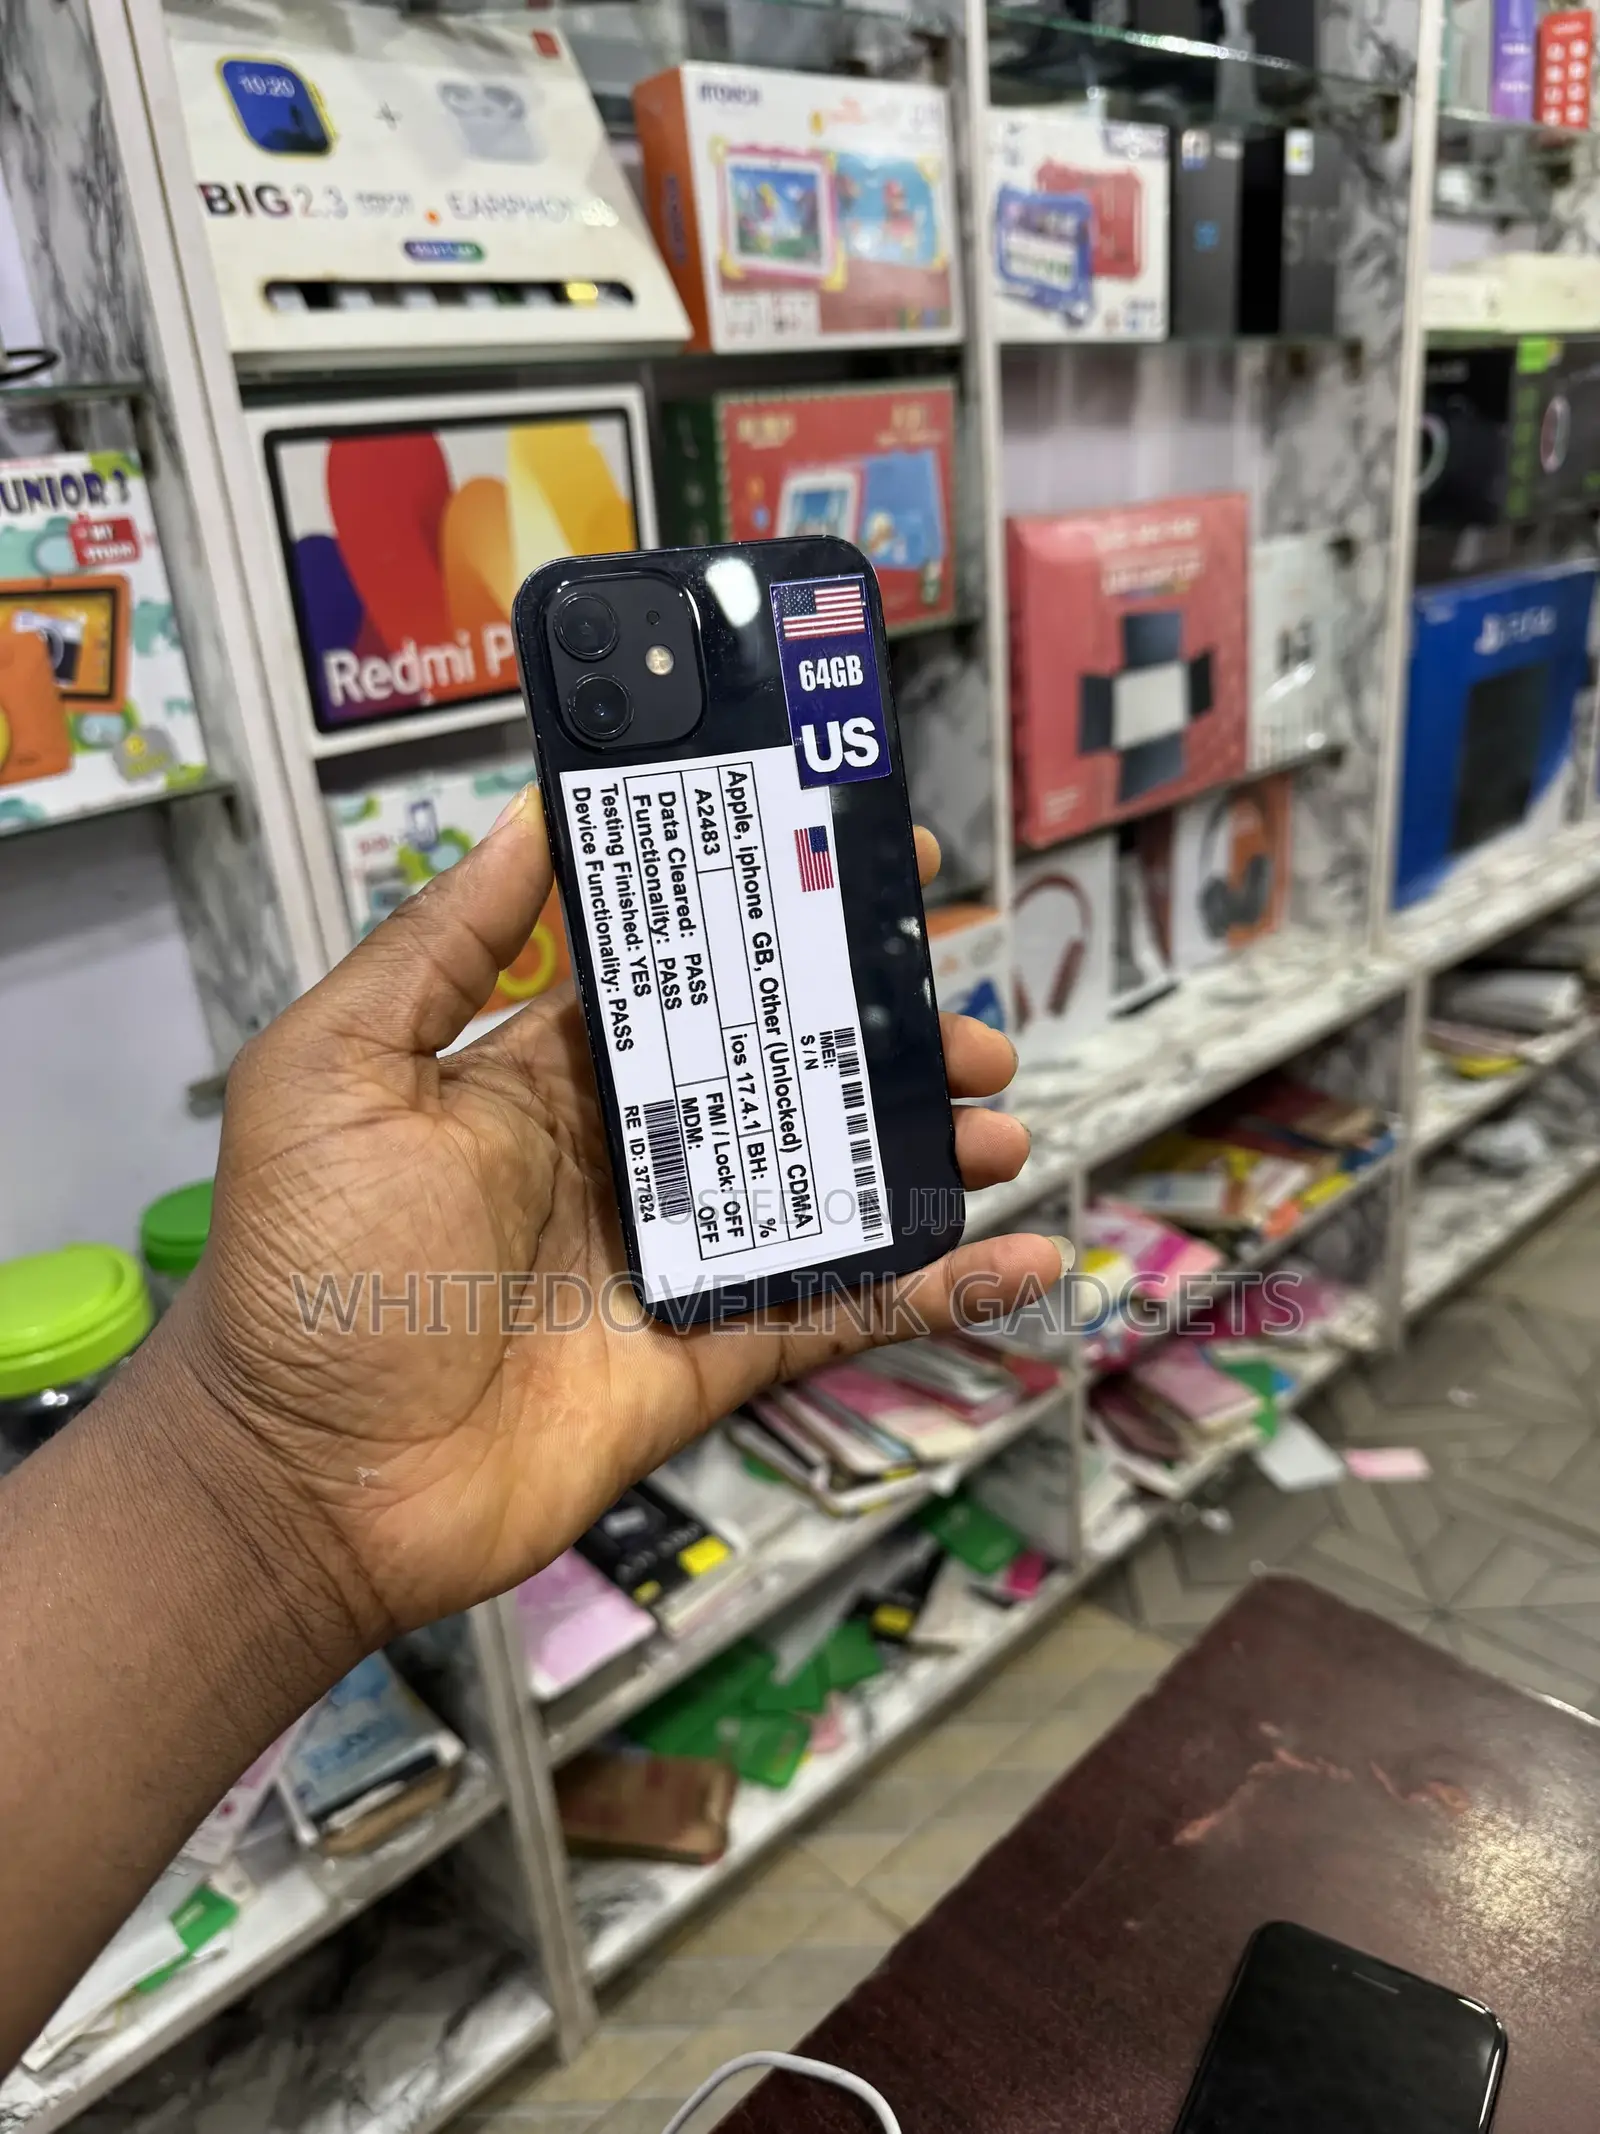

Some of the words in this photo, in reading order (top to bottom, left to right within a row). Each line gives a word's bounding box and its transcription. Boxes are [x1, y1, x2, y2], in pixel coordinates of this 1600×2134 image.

[196, 182, 292, 218] BIG
[323, 629, 476, 707] Redmi
[798, 654, 864, 692] 64GB
[800, 716, 880, 773] US
[600, 783, 625, 857] Testing
[657, 790, 680, 842] Data
[694, 788, 721, 856] A2483
[724, 770, 754, 840] Apple,
[612, 861, 644, 952] Finished:
[632, 794, 670, 945] Functionality:
[657, 957, 683, 1011] PASS
[667, 847, 697, 938] Cleared:
[735, 845, 763, 920] iphone
[572, 787, 598, 855] Device
[585, 859, 621, 993] Functionality:
[608, 998, 635, 1052] PASS
[629, 955, 652, 998] YES
[683, 953, 709, 1006] PASS
[752, 931, 775, 972] GB,
[758, 977, 782, 1036] Other
[730, 1033, 748, 1067] ios
[818, 1030, 837, 1069] IMEI:
[623, 1104, 642, 1130] RE
[705, 1091, 728, 1127] FMI
[736, 1072, 762, 1131] 17.4.1
[763, 1041, 803, 1154] (Unlocked)
[629, 1137, 646, 1161] ID:
[680, 1096, 704, 1150] MDM:
[697, 1205, 720, 1243] OFF
[713, 1140, 736, 1193] Lock:
[633, 1165, 656, 1223] 377824
[723, 1200, 745, 1237] OFF
[746, 1141, 768, 1181] BH:
[758, 1217, 778, 1239] %
[786, 1164, 814, 1230] CDMA
